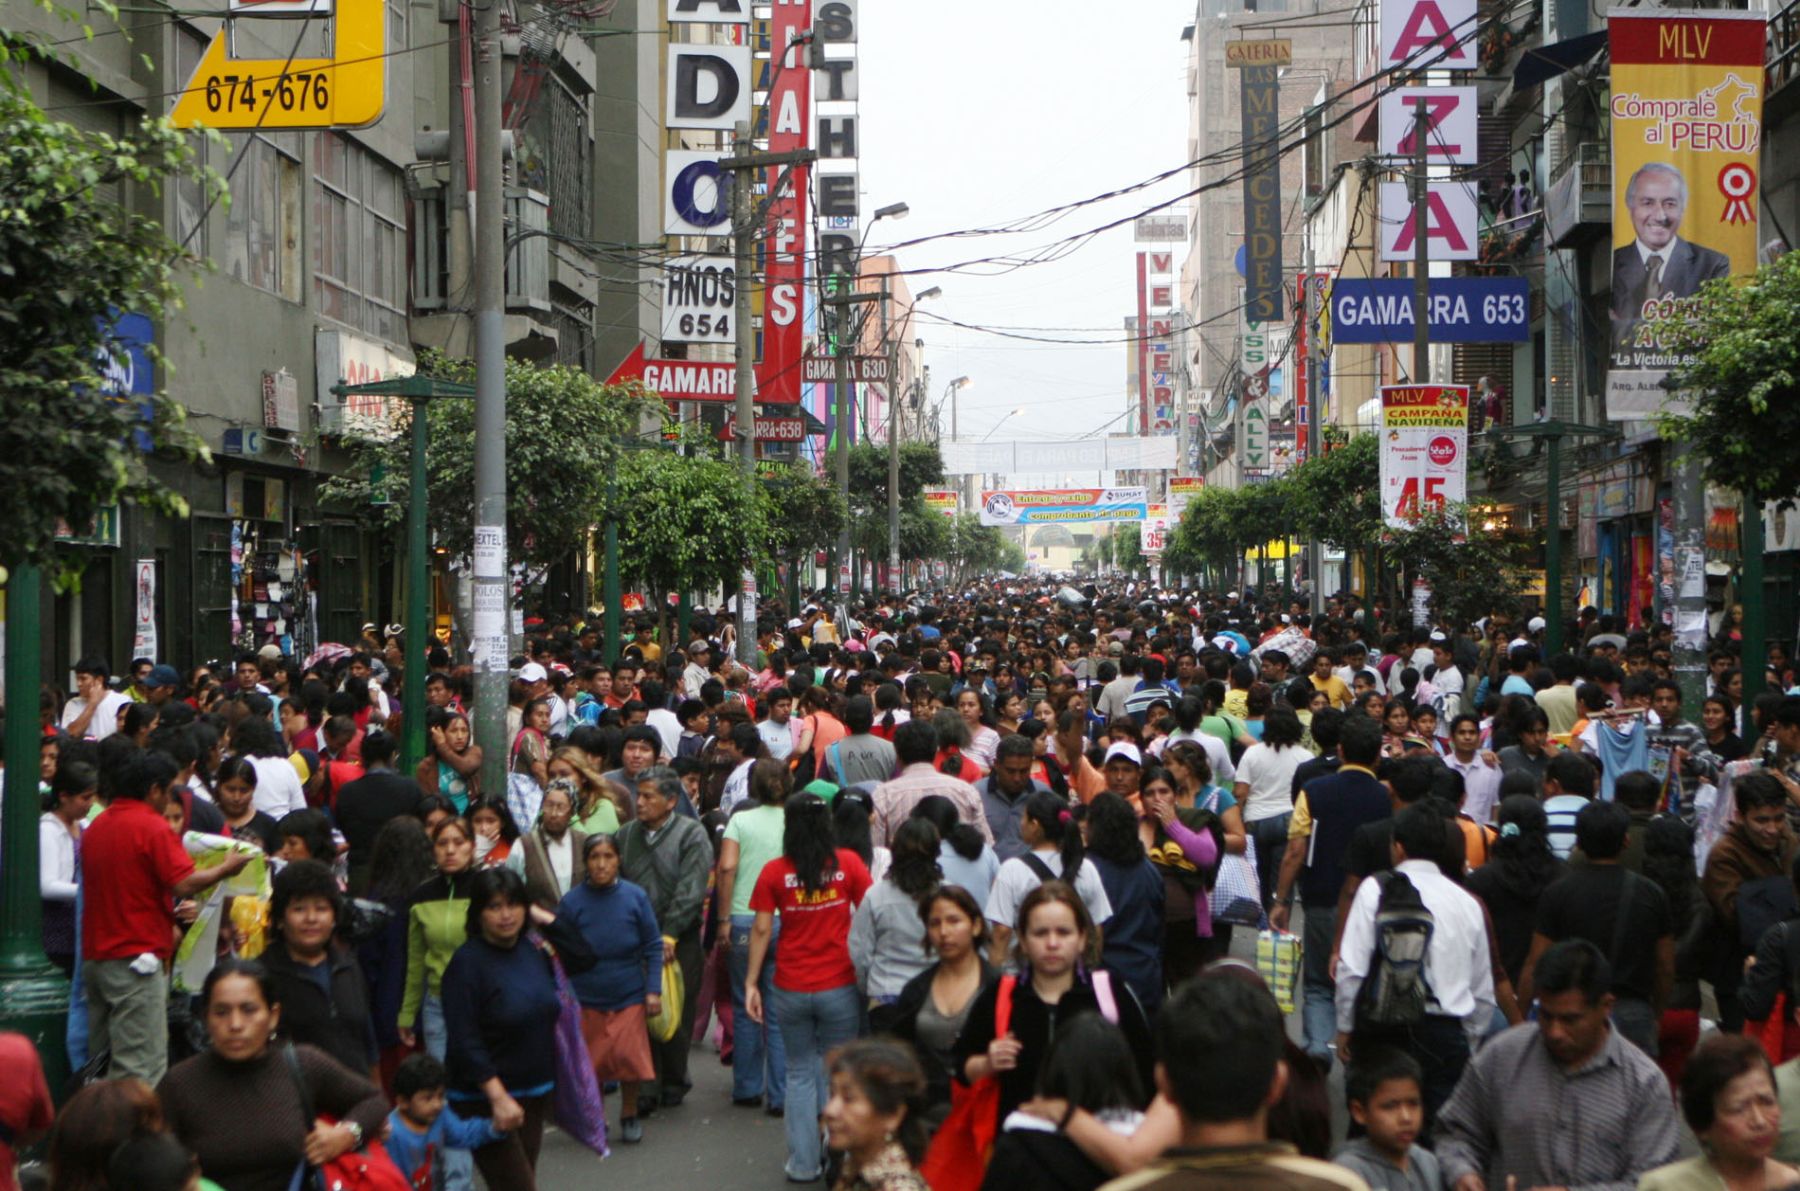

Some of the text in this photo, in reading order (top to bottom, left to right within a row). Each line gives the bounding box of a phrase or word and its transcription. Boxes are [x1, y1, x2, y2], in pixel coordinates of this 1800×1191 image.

[1660, 24, 1712, 59] MLV
[206, 73, 329, 113] 674-676
[1610, 94, 1716, 123] Cómprale
[1646, 116, 1747, 151] al PERÚ
[668, 265, 735, 308] HNOS
[680, 313, 729, 337] 654
[1338, 294, 1526, 326] GAMARA 653
[862, 359, 887, 378] 630
[1633, 353, 1679, 366] Victoria
[1391, 388, 1425, 404] MLV
[1395, 477, 1446, 526] 45
[1147, 533, 1162, 548] 35
